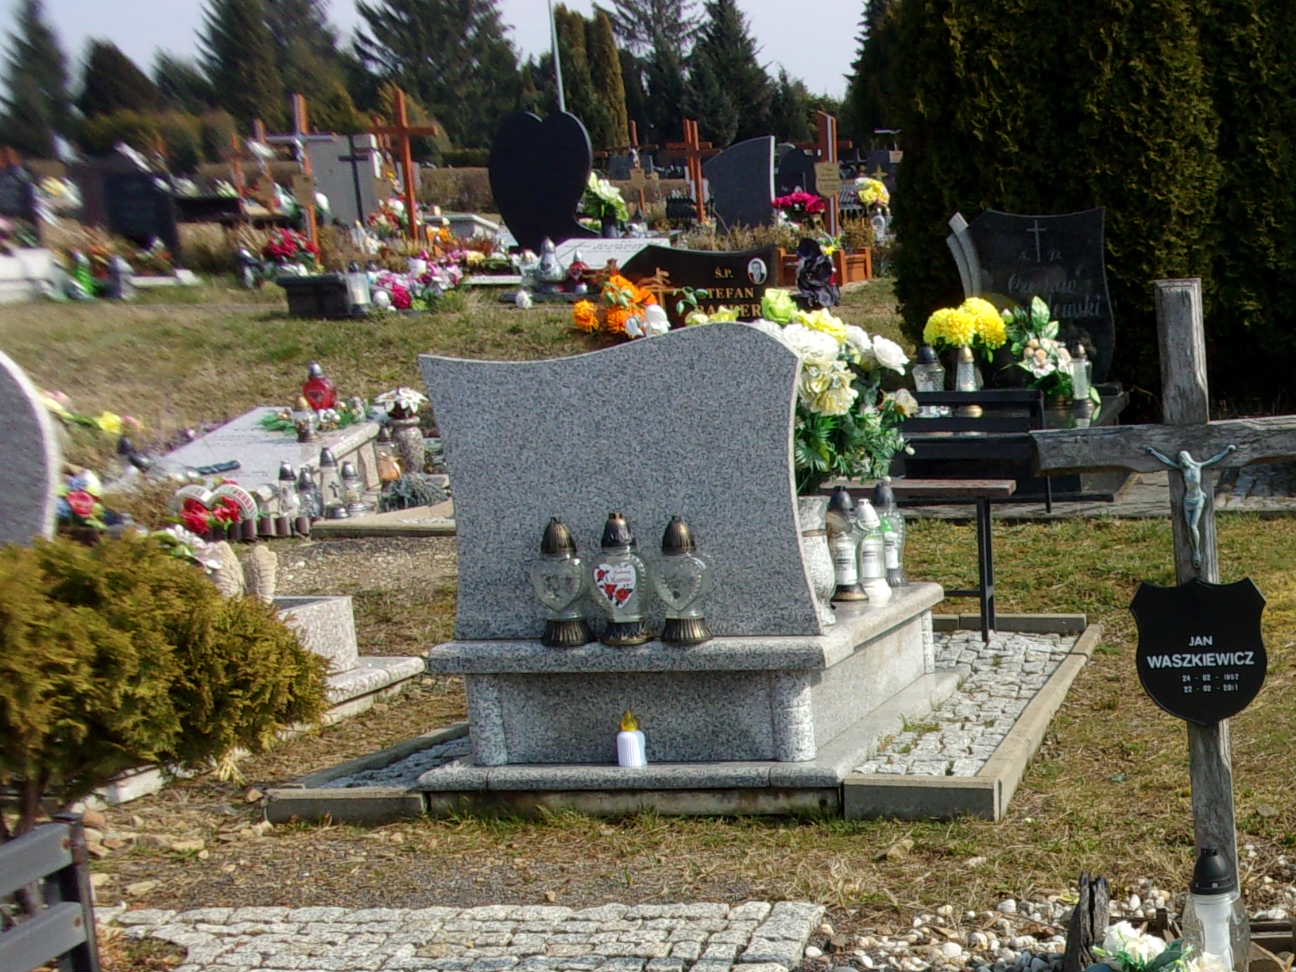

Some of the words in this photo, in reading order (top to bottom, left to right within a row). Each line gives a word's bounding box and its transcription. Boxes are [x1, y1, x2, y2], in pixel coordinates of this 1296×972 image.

[701, 287, 755, 299] TEFAN
[1188, 635, 1213, 647] JAN
[1147, 651, 1255, 669] WASZKIEWICZ
